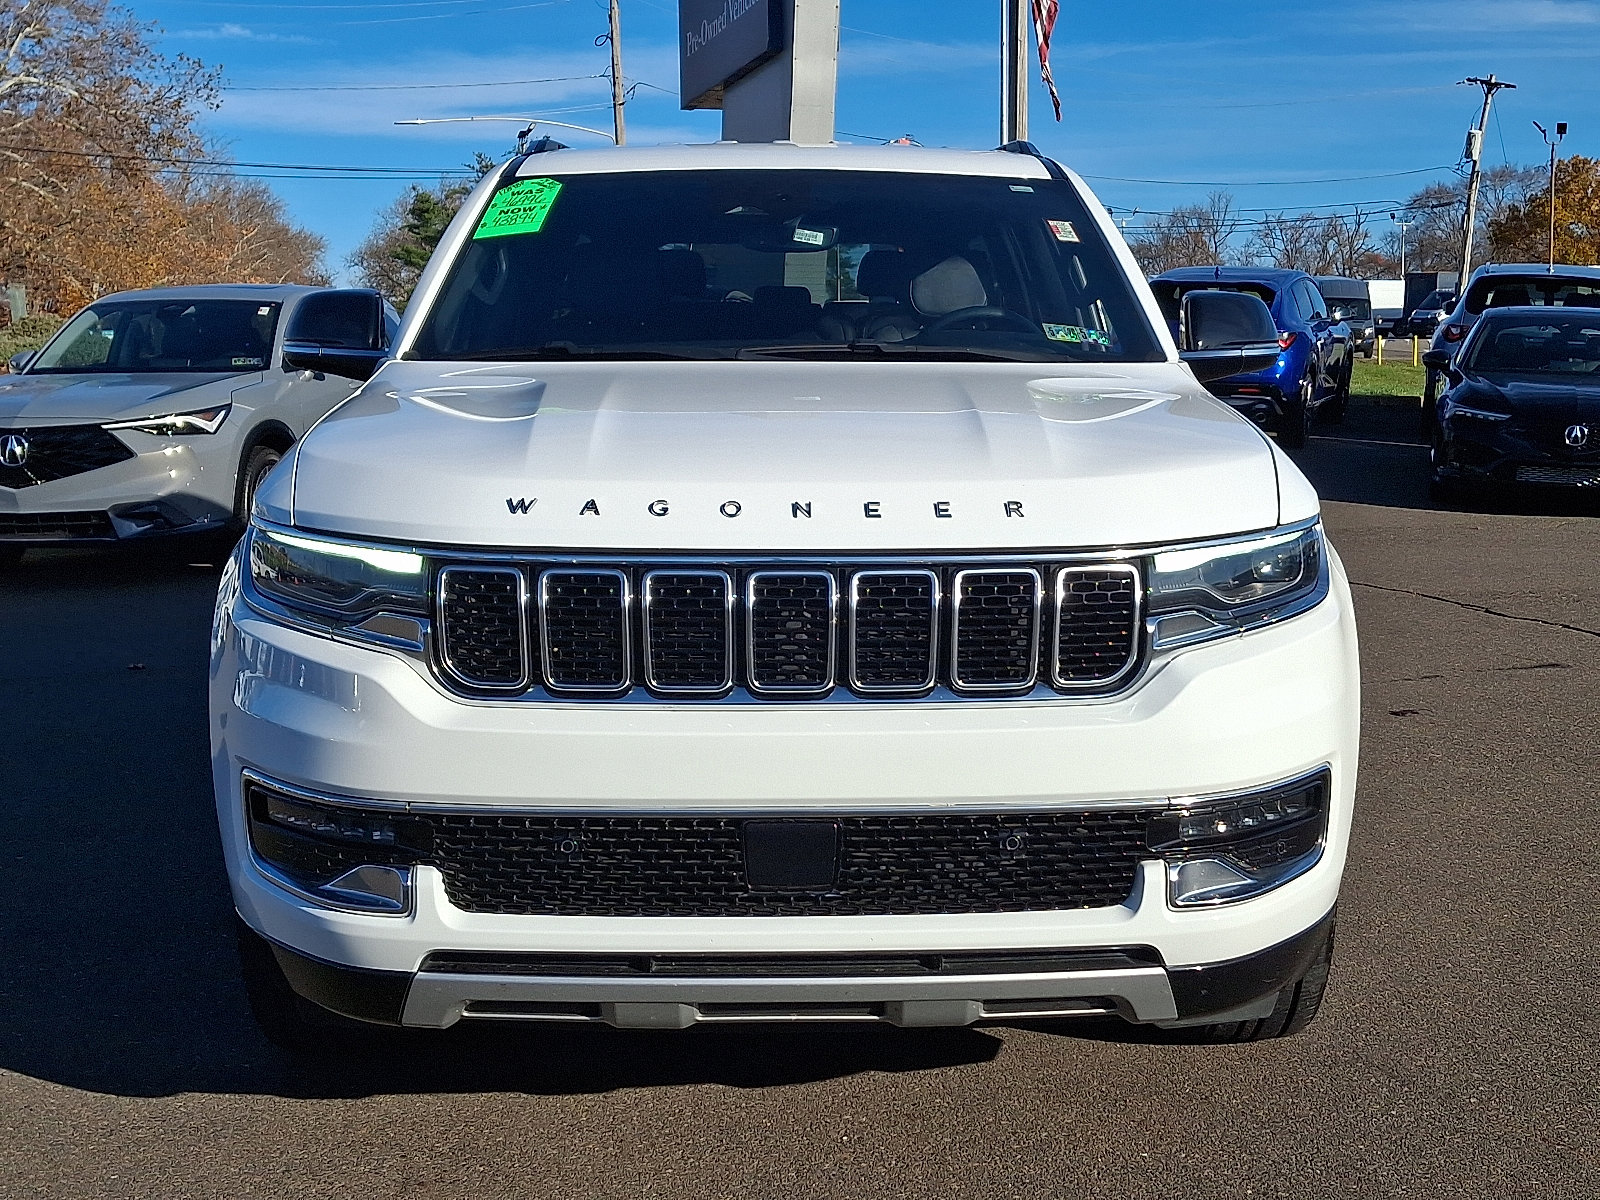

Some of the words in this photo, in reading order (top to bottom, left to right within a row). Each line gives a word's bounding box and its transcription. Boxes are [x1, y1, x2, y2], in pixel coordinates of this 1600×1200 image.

[686, 1, 727, 56] Pre-Owned
[511, 187, 545, 196] WAS
[498, 206, 537, 215] NOW
[506, 497, 1026, 519] WAGONEER
